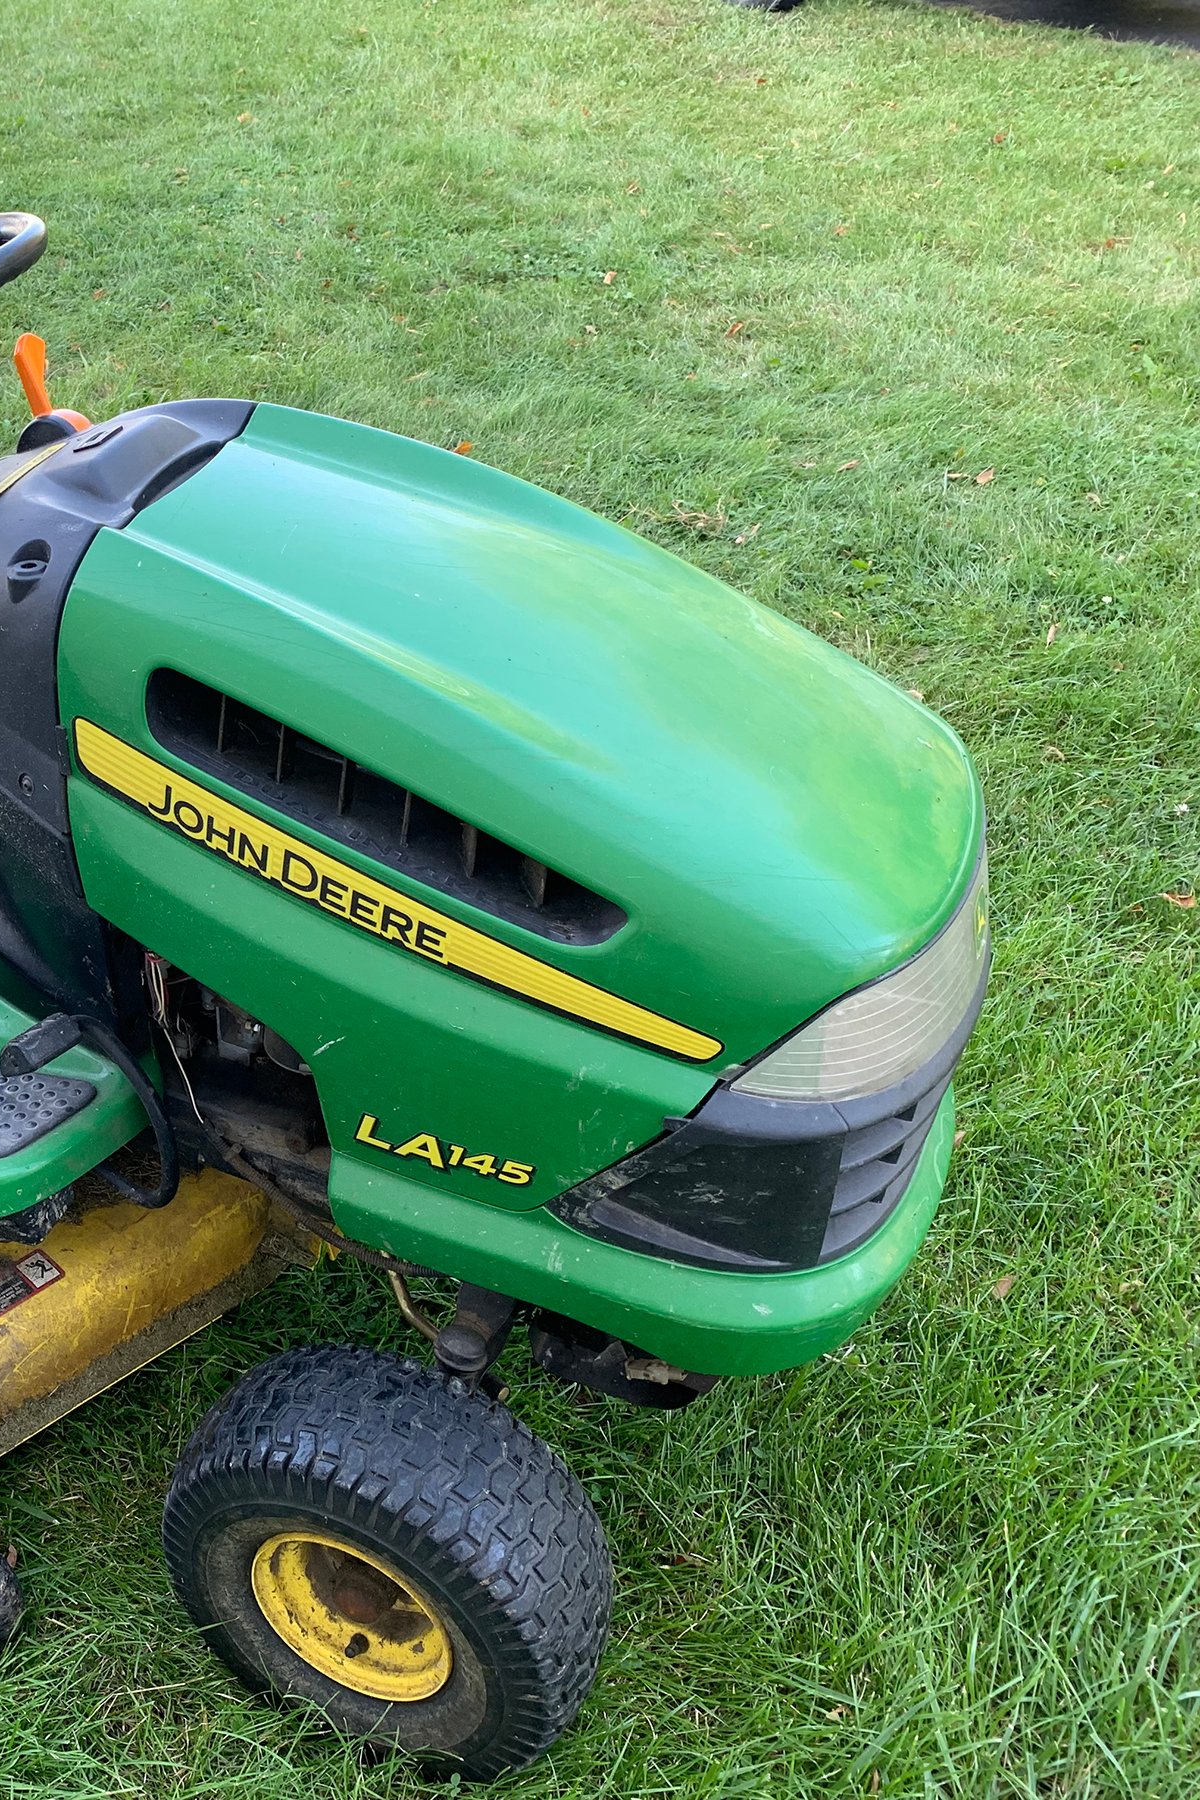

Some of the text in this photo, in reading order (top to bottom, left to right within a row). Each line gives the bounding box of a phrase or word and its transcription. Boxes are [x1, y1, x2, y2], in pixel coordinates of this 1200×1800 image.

[148, 784, 447, 958] JOHN DEERE
[354, 1112, 536, 1186] LA145
